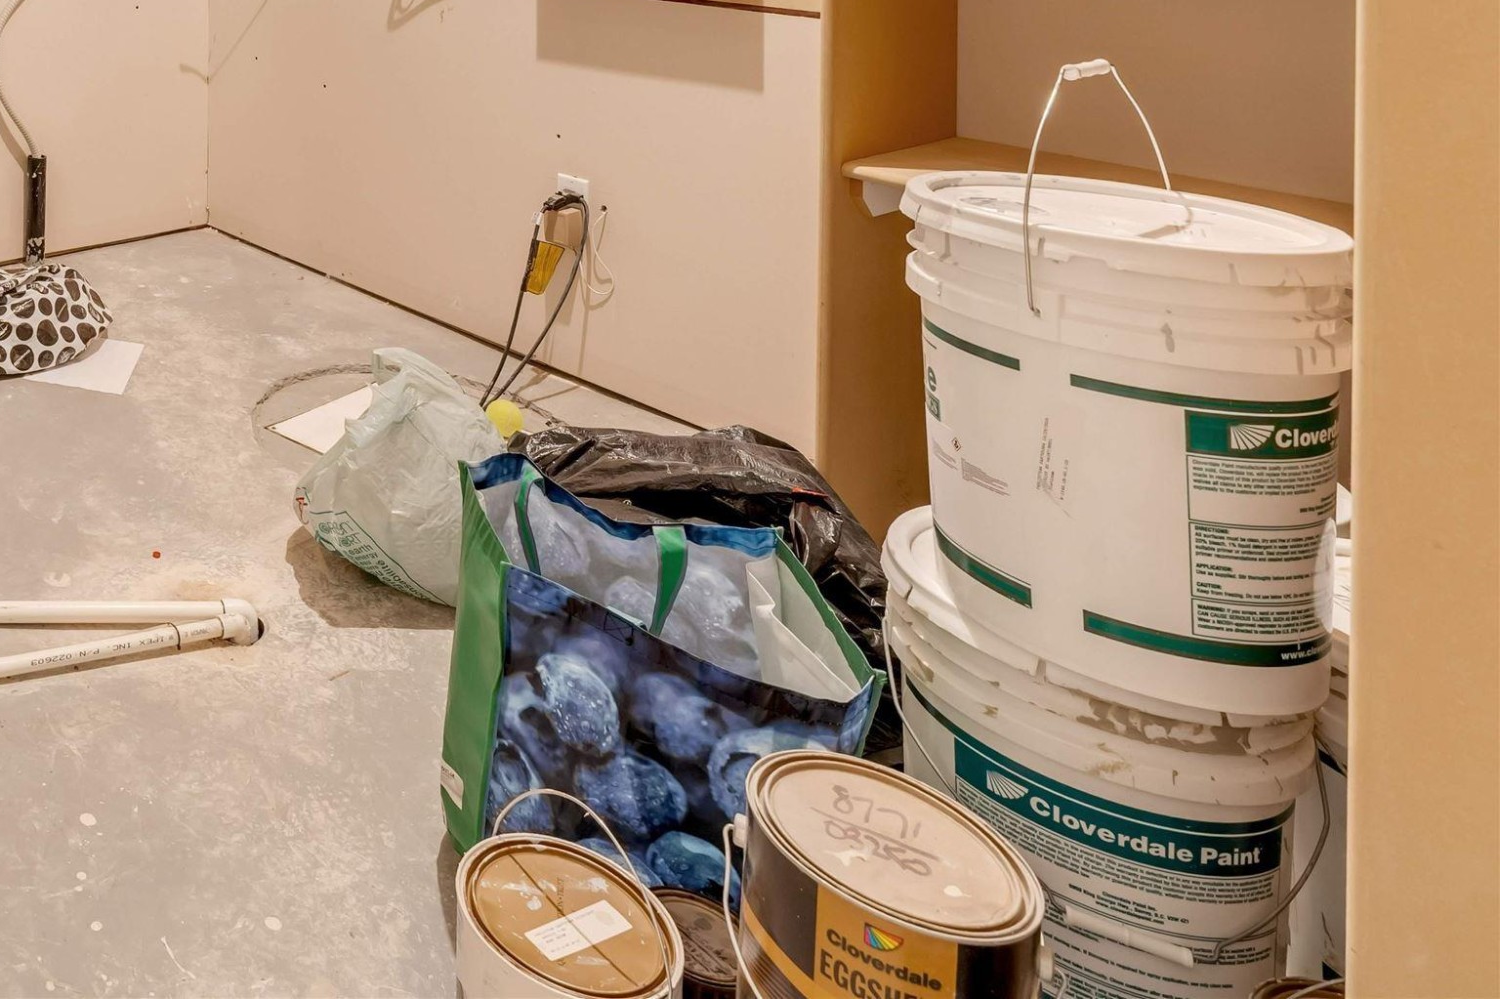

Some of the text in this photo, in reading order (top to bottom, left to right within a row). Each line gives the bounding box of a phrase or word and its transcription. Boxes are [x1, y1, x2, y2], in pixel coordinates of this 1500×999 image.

[348, 544, 373, 556] earth
[107, 641, 131, 651] INC.
[138, 635, 164, 646] IPEX
[29, 652, 72, 666] 022603
[1029, 796, 1194, 863] Cloverdale
[1200, 847, 1262, 869] Paint
[826, 928, 942, 991] Cloverdale
